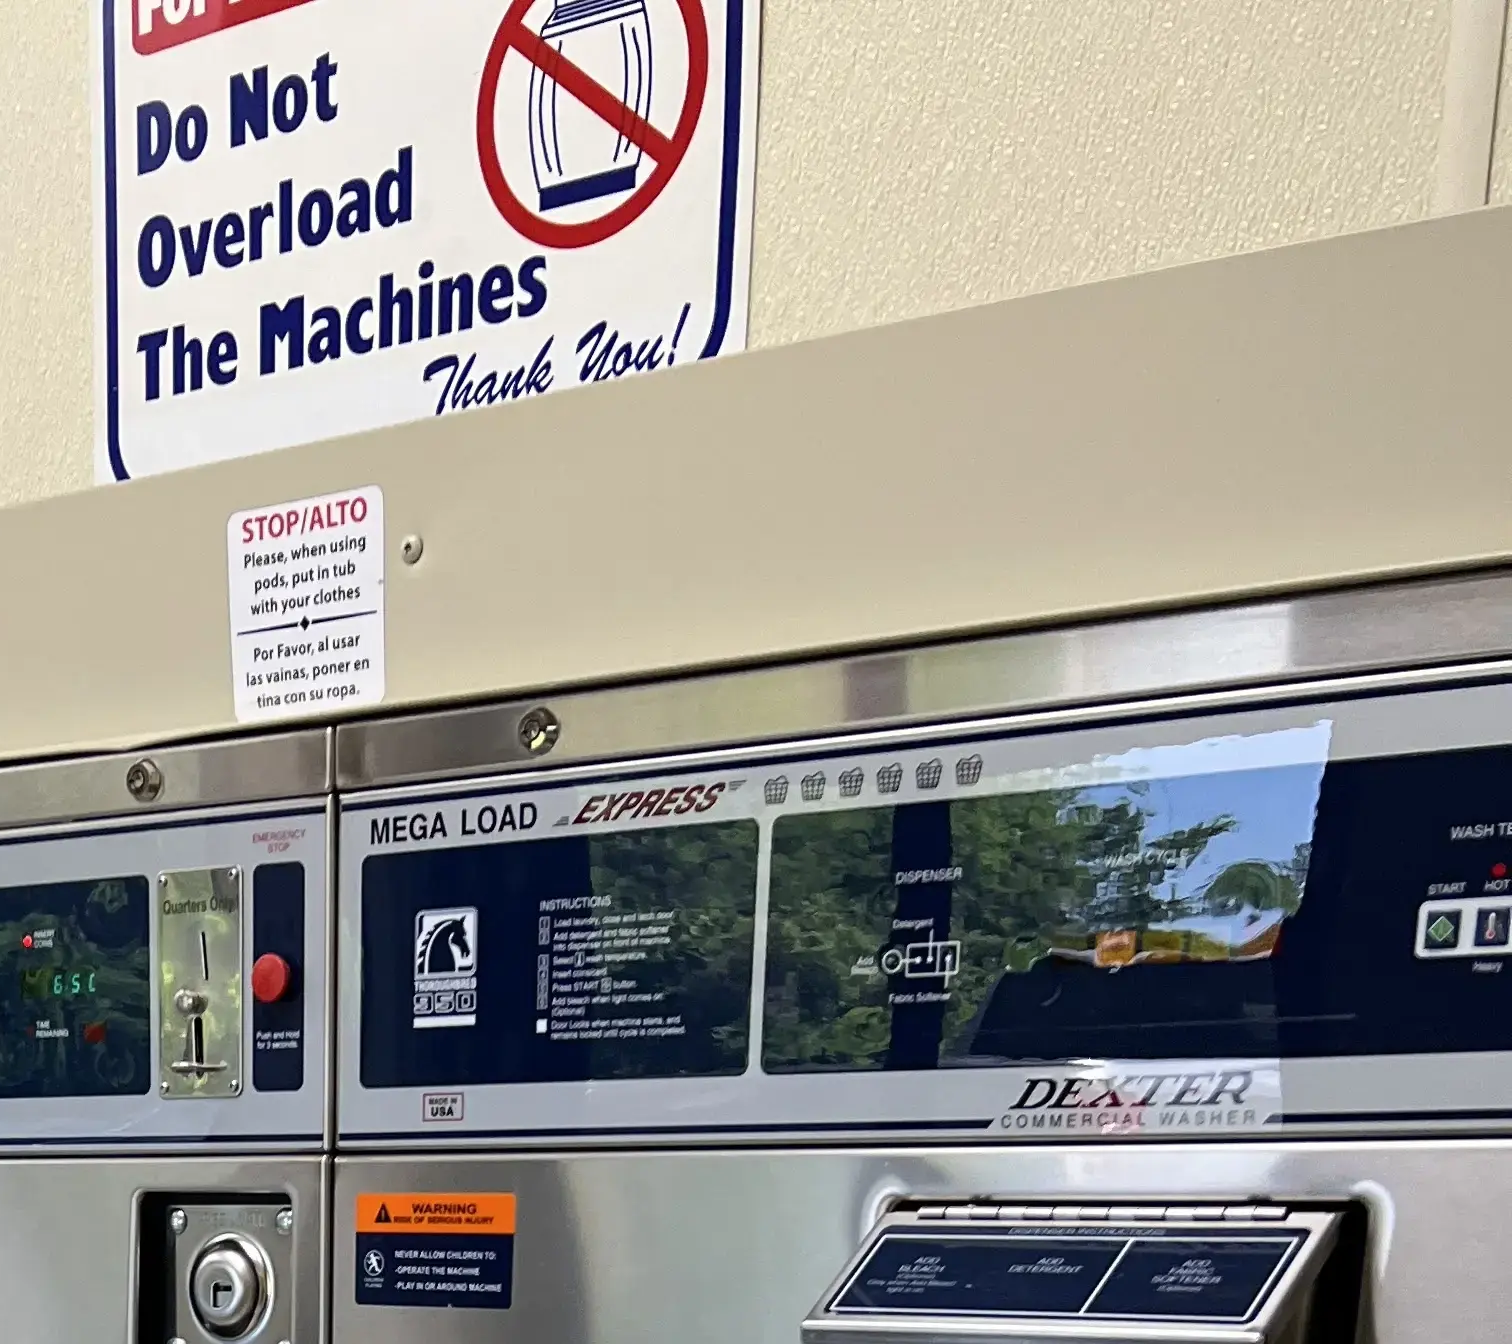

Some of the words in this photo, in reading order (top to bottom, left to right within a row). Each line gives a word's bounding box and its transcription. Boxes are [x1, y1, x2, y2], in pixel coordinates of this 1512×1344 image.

[136, 100, 208, 176] Do
[228, 52, 340, 149] Not
[136, 145, 414, 289] Overload
[136, 323, 238, 402] The
[259, 254, 549, 377] Machines
[422, 335, 555, 417] Thank
[575, 302, 692, 384] You!
[242, 496, 368, 544] STOP/ALTO
[244, 551, 288, 568] Please,
[291, 543, 326, 561] when
[330, 534, 367, 553] using
[254, 574, 289, 594] pods,
[292, 568, 314, 589] put
[317, 565, 330, 580] in
[333, 560, 356, 576] tub
[251, 597, 278, 616] with
[281, 594, 310, 615] your
[313, 585, 361, 605] clothes
[253, 647, 274, 662] Por
[277, 641, 315, 658] Favor,
[318, 635, 329, 652] al
[332, 634, 361, 649] usar
[246, 671, 263, 687] las
[266, 666, 310, 685] vainas,
[313, 661, 351, 680] poner
[354, 657, 370, 671] en
[257, 693, 281, 709] tina
[284, 692, 307, 705] con
[309, 689, 324, 700] su
[327, 683, 361, 702] ropa.
[370, 812, 448, 845] MEGA
[460, 802, 538, 836] LOAD
[572, 781, 726, 826] EXPRESS
[252, 828, 307, 844] EMERGENCY
[1451, 824, 1494, 841] WASH
[267, 843, 290, 854] STOP
[895, 867, 963, 885] DISPENSER
[1427, 881, 1467, 896] START
[1483, 879, 1511, 891] HOT
[163, 899, 207, 916] Quarters
[540, 895, 612, 911] INSTRUCTIONS
[1008, 1070, 1253, 1110] DEXTER
[431, 1106, 454, 1117] USA
[1000, 1111, 1147, 1129] COMMERCIAL
[1159, 1109, 1256, 1126] WASHER
[412, 1203, 477, 1215] WARNING
[394, 1250, 419, 1259] NEVER
[419, 1250, 445, 1259] ALLOW
[446, 1251, 483, 1260] CHILDREN
[914, 1256, 941, 1264] ADD
[1037, 1257, 1064, 1265] ADD
[1182, 1259, 1212, 1267] ADD
[432, 1266, 445, 1275] THE
[1007, 1265, 1084, 1273] DETERGENT
